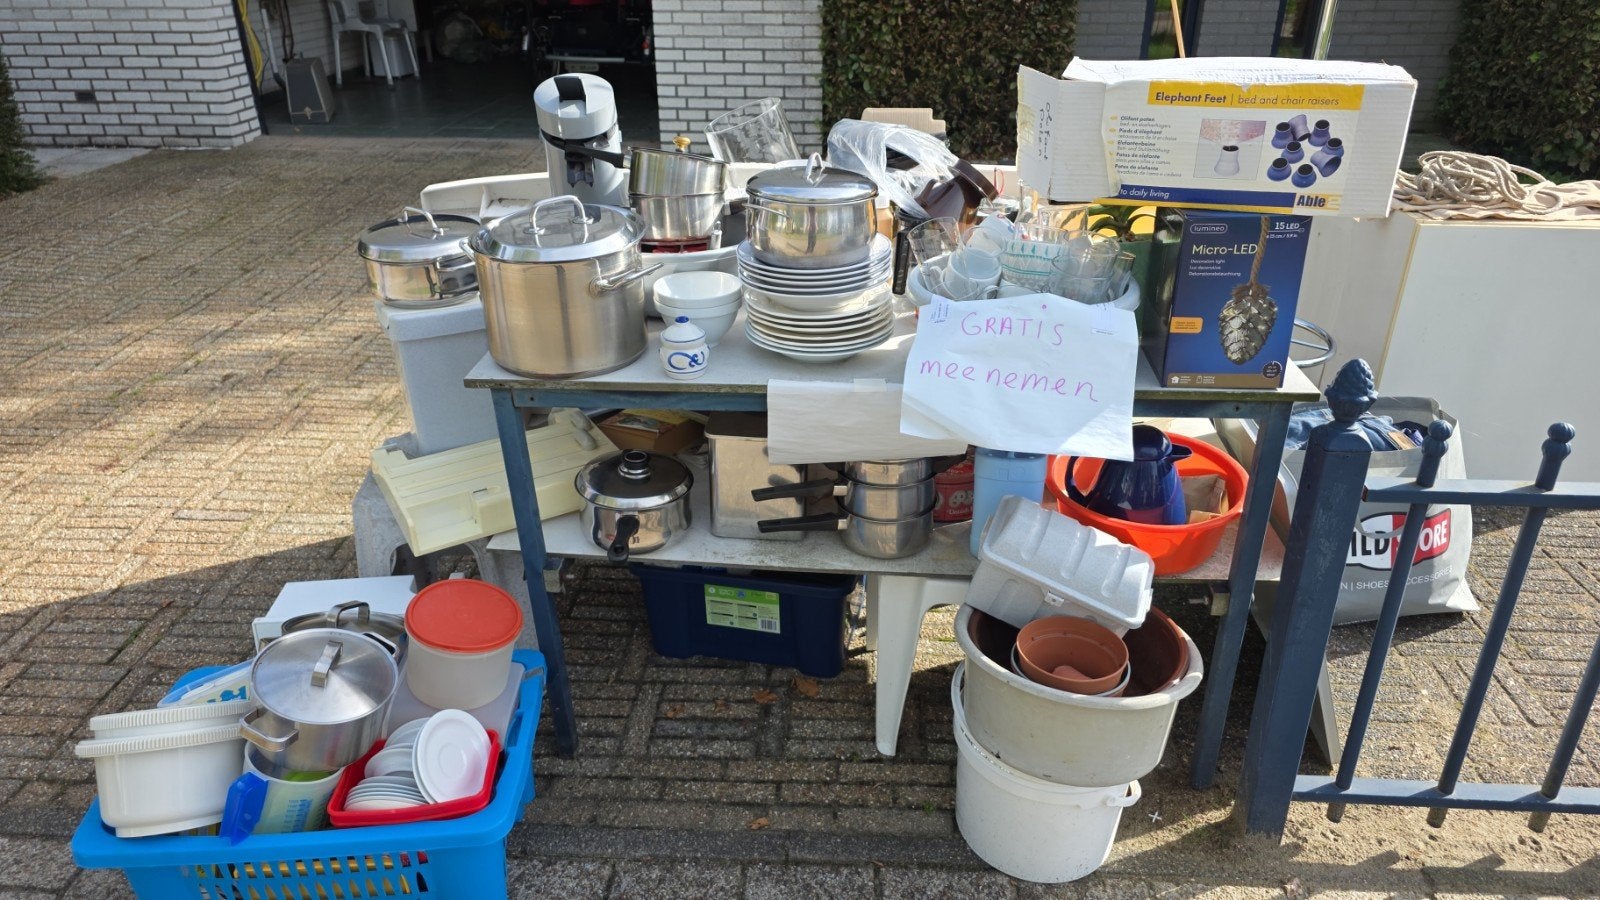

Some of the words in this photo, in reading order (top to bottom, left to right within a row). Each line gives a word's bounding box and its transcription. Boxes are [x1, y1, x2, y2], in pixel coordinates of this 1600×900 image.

[1156, 92, 1201, 104] Elephant
[1205, 94, 1226, 103] Feet
[1238, 94, 1256, 104] bed
[1260, 94, 1278, 104] and
[1281, 95, 1305, 105] chair
[1308, 96, 1339, 105] raisers
[1130, 188, 1148, 198] daily
[1150, 189, 1170, 199] living
[1275, 222, 1285, 230] 15
[1192, 244, 1258, 255] Micro-LED
[961, 311, 1064, 346] GRATIS
[1351, 531, 1390, 556] ILD
